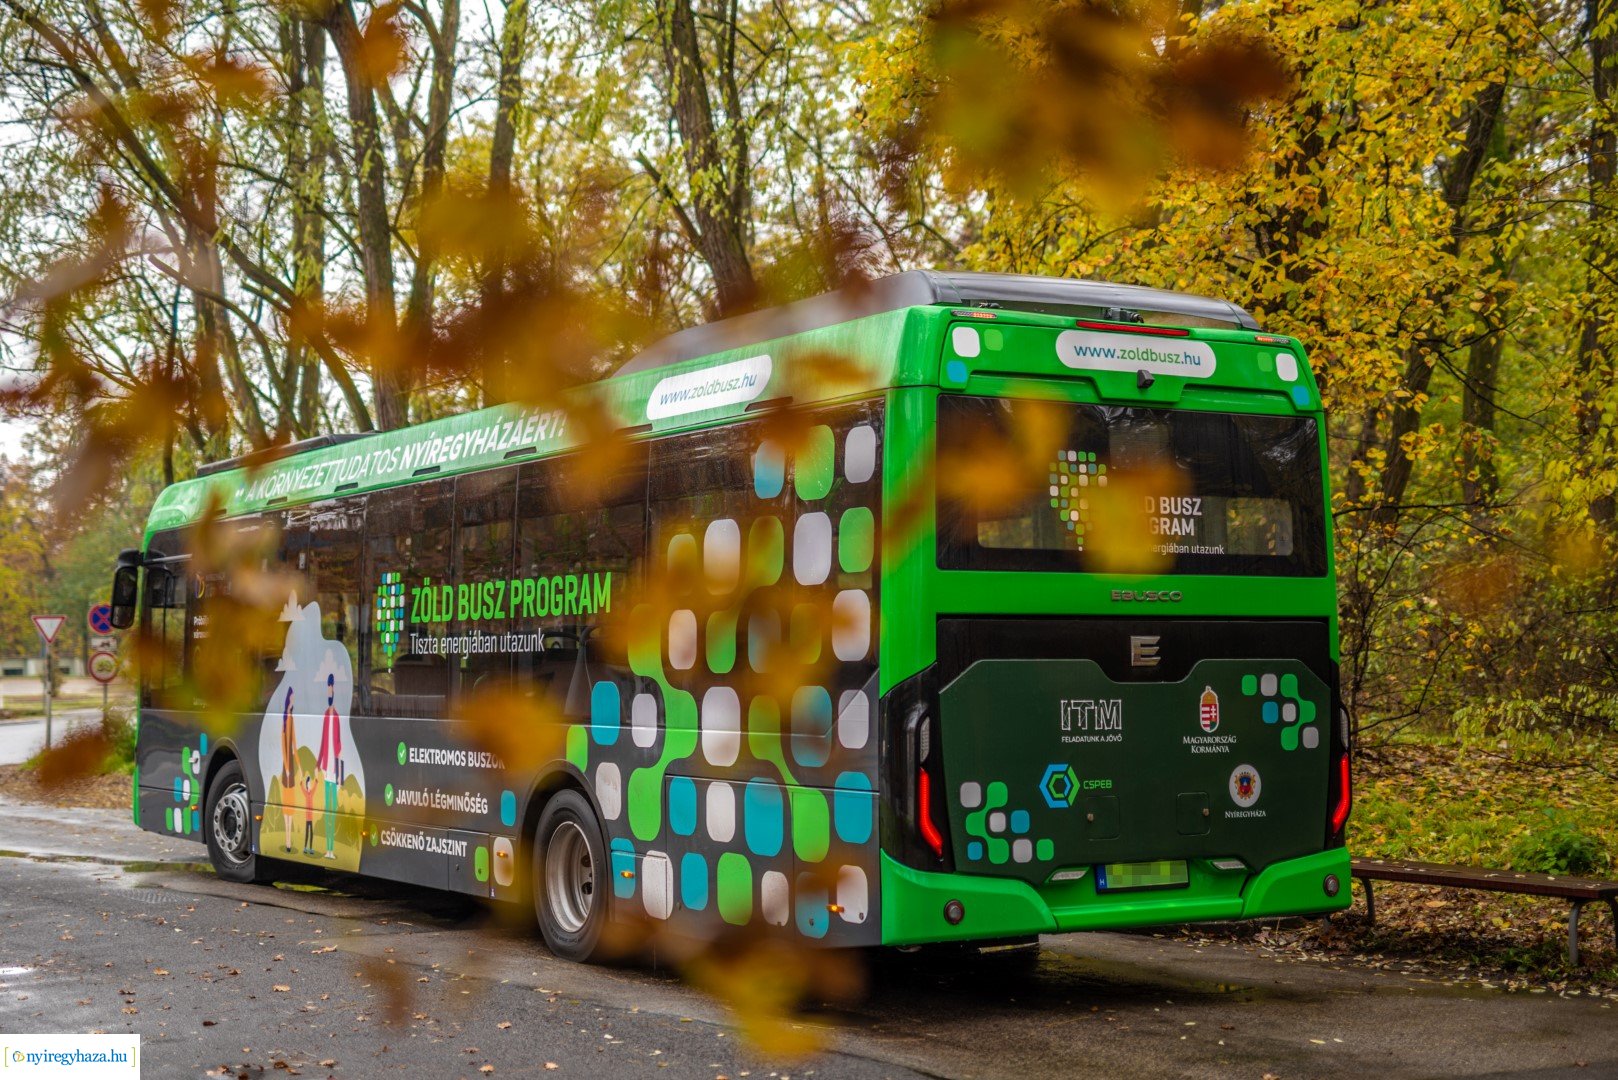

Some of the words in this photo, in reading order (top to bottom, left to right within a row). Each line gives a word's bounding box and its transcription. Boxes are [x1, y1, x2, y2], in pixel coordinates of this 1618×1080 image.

[1074, 344, 1201, 366] www.zoldbusz.hu
[660, 373, 757, 405] www.zoldbusz.hu
[258, 447, 400, 498] KÖRNYEZETTUDATOS
[399, 407, 568, 471] NYÍREGYHÁZÁÉRT!
[1160, 496, 1202, 516] BUSZ
[1149, 517, 1195, 536] GRAM
[1146, 542, 1189, 556] ergiában
[1191, 544, 1225, 555] utazunk
[410, 577, 454, 624] ZÖLD
[458, 580, 506, 621] BUSZ
[510, 572, 612, 619] PROGRAM
[1111, 589, 1183, 602] EBUSCO
[410, 632, 438, 655] Tiszta
[440, 630, 497, 660] energiában
[500, 627, 545, 652] utazunk
[1060, 699, 1122, 731] ITM
[1061, 735, 1100, 743] FELADATUNK
[409, 747, 466, 768] ELEKTROMOS
[396, 787, 429, 807] JAVULÓ
[430, 789, 488, 815] LÉGMINŐSÉG
[380, 827, 424, 850] CSÖKKENŐ
[425, 836, 467, 858] ZAJSZINT
